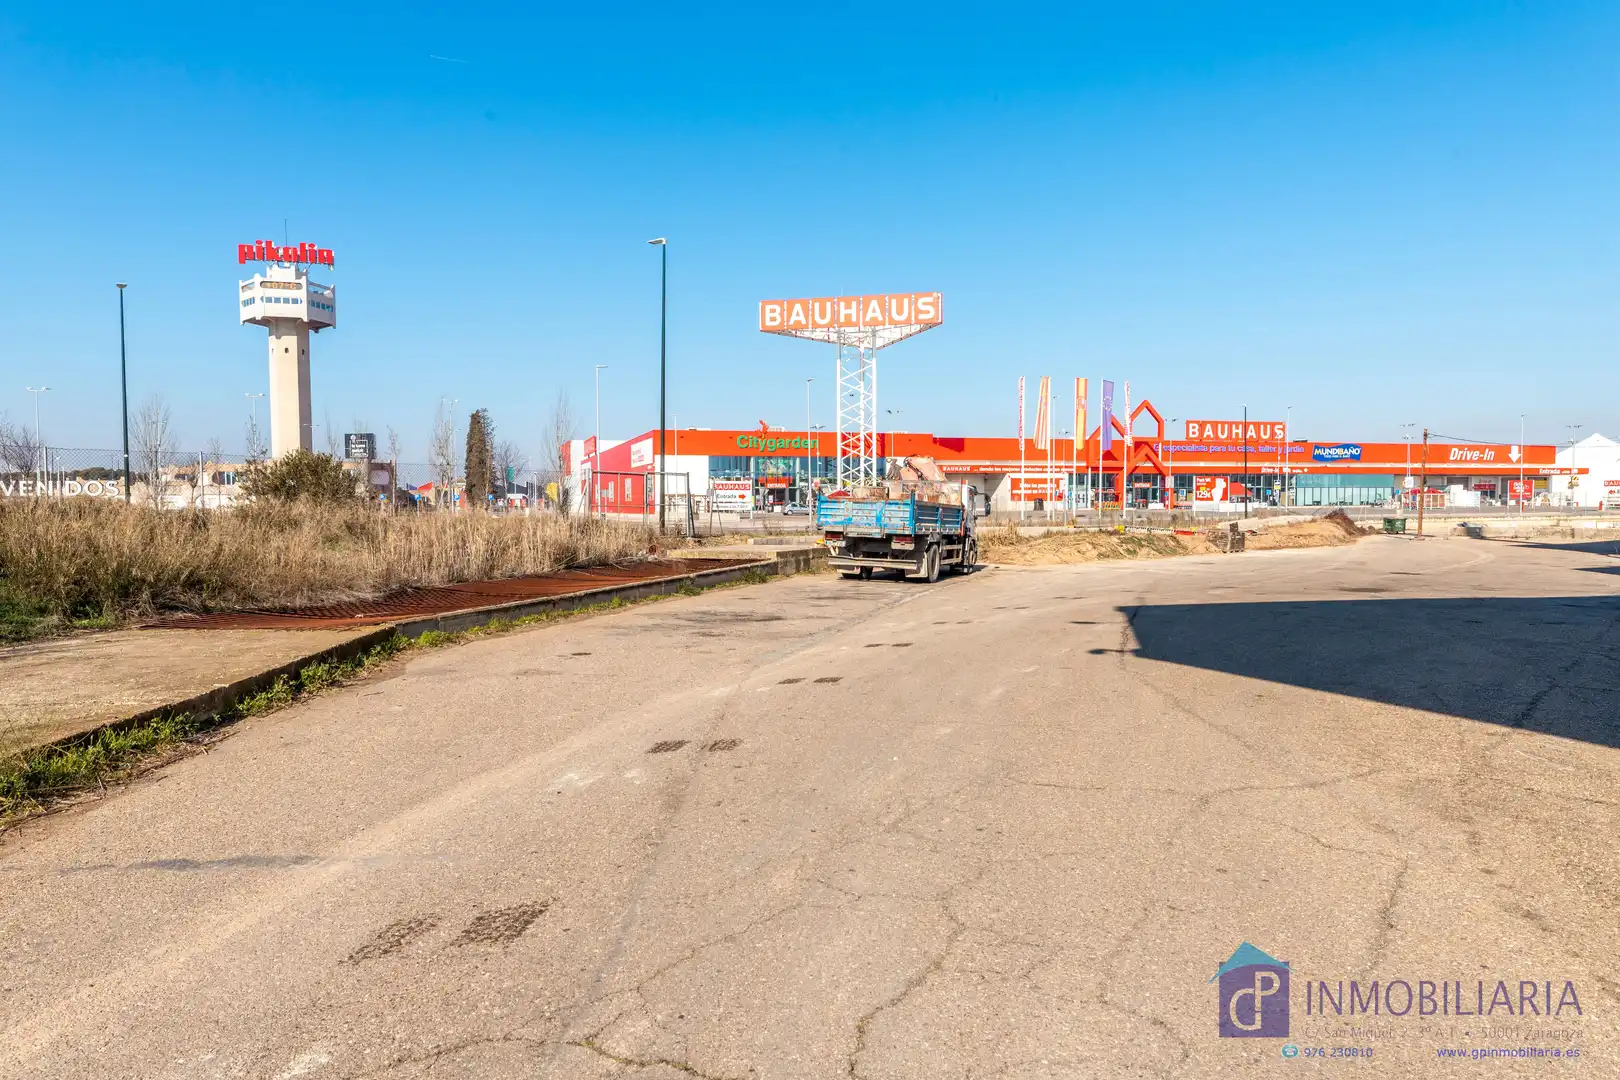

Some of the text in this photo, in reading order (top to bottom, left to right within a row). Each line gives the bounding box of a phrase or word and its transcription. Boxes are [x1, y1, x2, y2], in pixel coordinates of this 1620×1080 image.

[764, 296, 936, 326] BAUHAUS
[1188, 423, 1285, 440] BAUHAUS
[737, 435, 819, 452] Citygarden
[1163, 444, 1208, 453] especialista
[1210, 445, 1227, 454] para
[1314, 446, 1361, 456] MUNDIBAÑO
[1449, 448, 1495, 461] Drive-In
